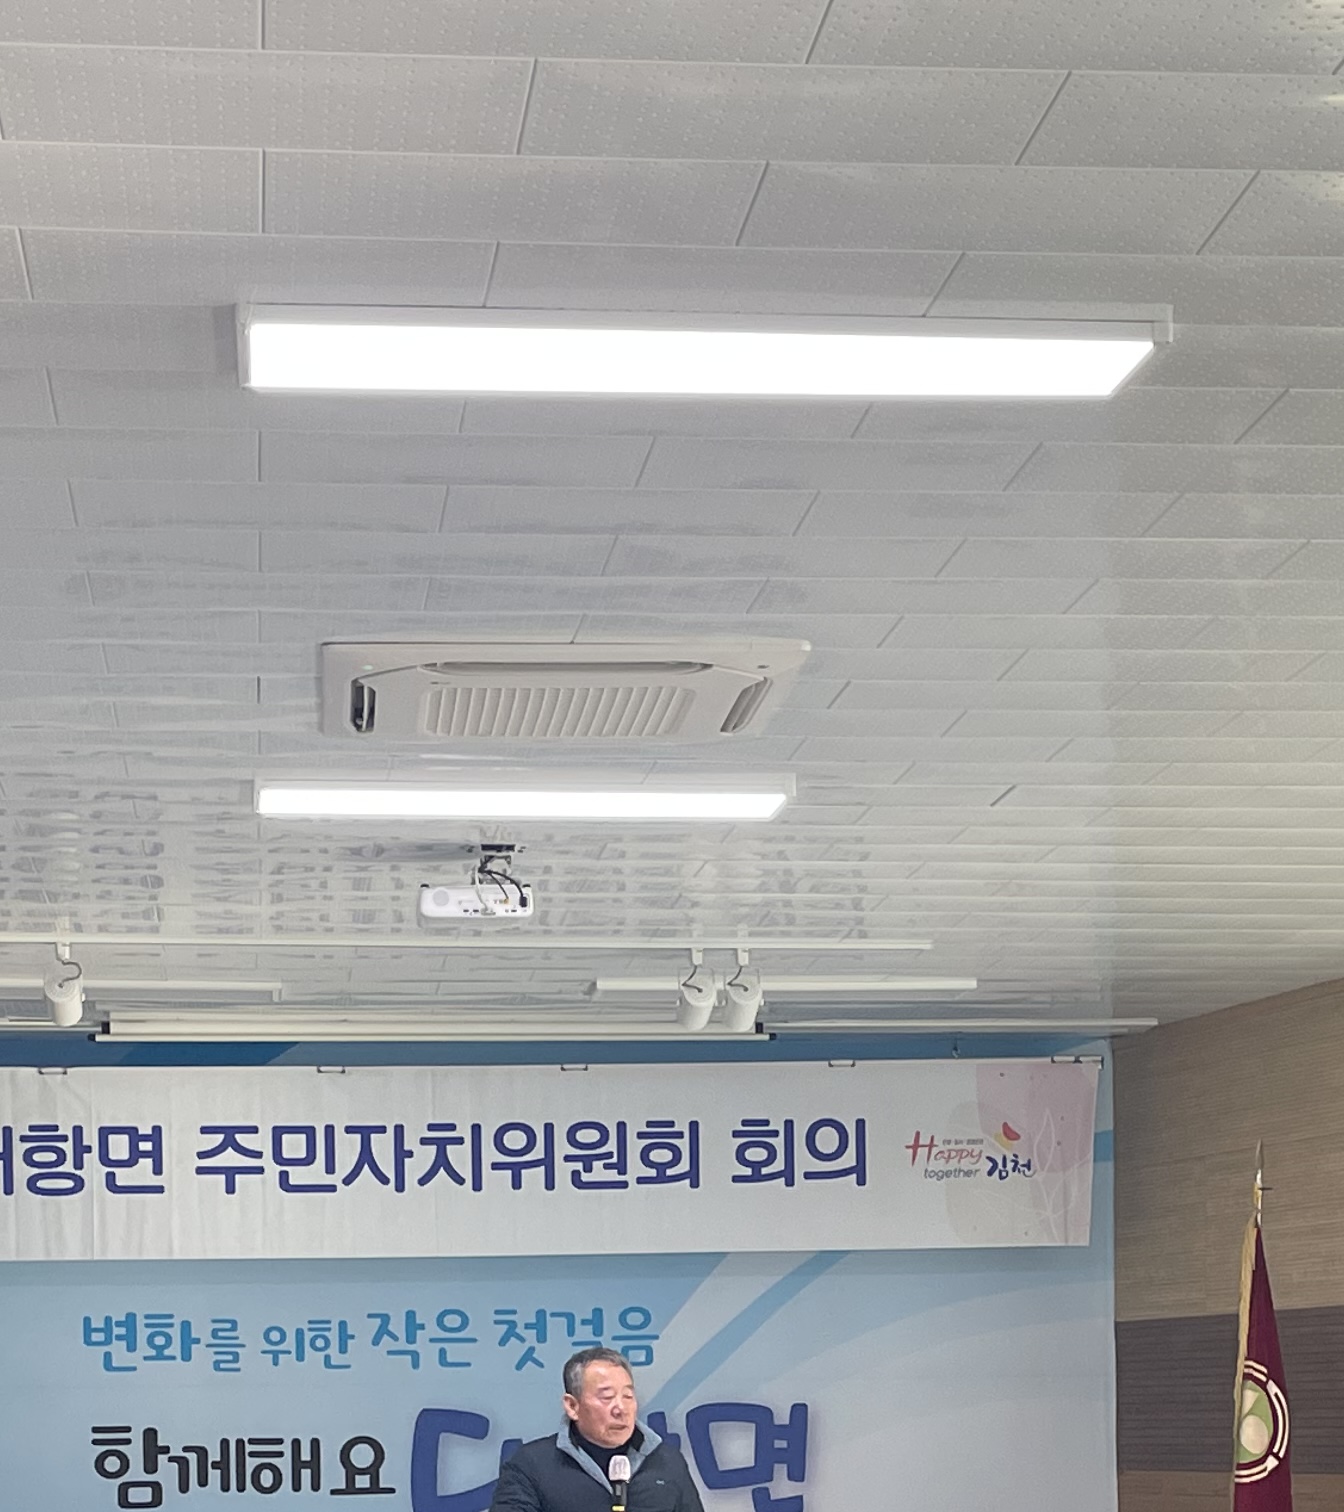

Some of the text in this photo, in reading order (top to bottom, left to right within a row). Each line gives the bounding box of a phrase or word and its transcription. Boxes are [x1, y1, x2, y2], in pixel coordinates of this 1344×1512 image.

[195, 1119, 701, 1194] 주민자치위원회
[730, 1116, 868, 1188] 회의
[905, 1130, 984, 1167] Happy
[923, 1166, 982, 1181] together
[985, 1152, 1037, 1181] 김천
[82, 1305, 660, 1373] 변화를 위한 작은 첫걸음
[90, 1424, 397, 1509] 함께해요
